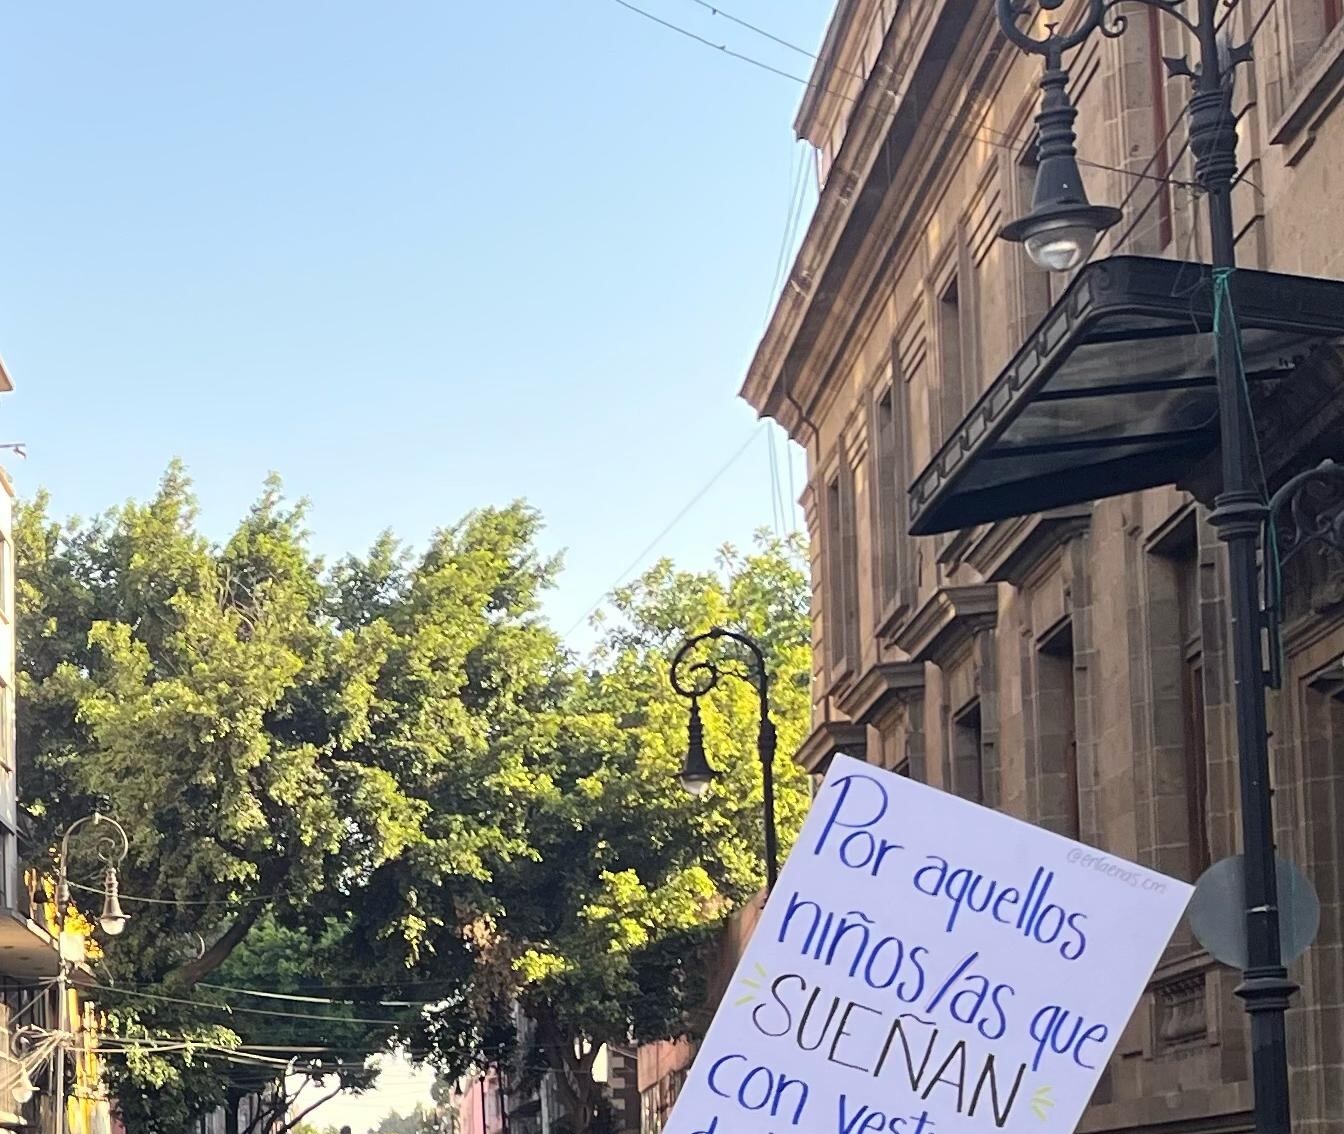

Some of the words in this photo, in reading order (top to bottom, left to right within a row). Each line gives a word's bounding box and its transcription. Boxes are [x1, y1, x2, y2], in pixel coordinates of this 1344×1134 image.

[814, 775, 904, 877] Por
[913, 855, 1088, 960] aquellos
[752, 974, 1026, 1128] SUEÑAN
[777, 892, 1015, 1040] niños/as
[1030, 1006, 1110, 1072] que
[708, 1053, 808, 1126] con
